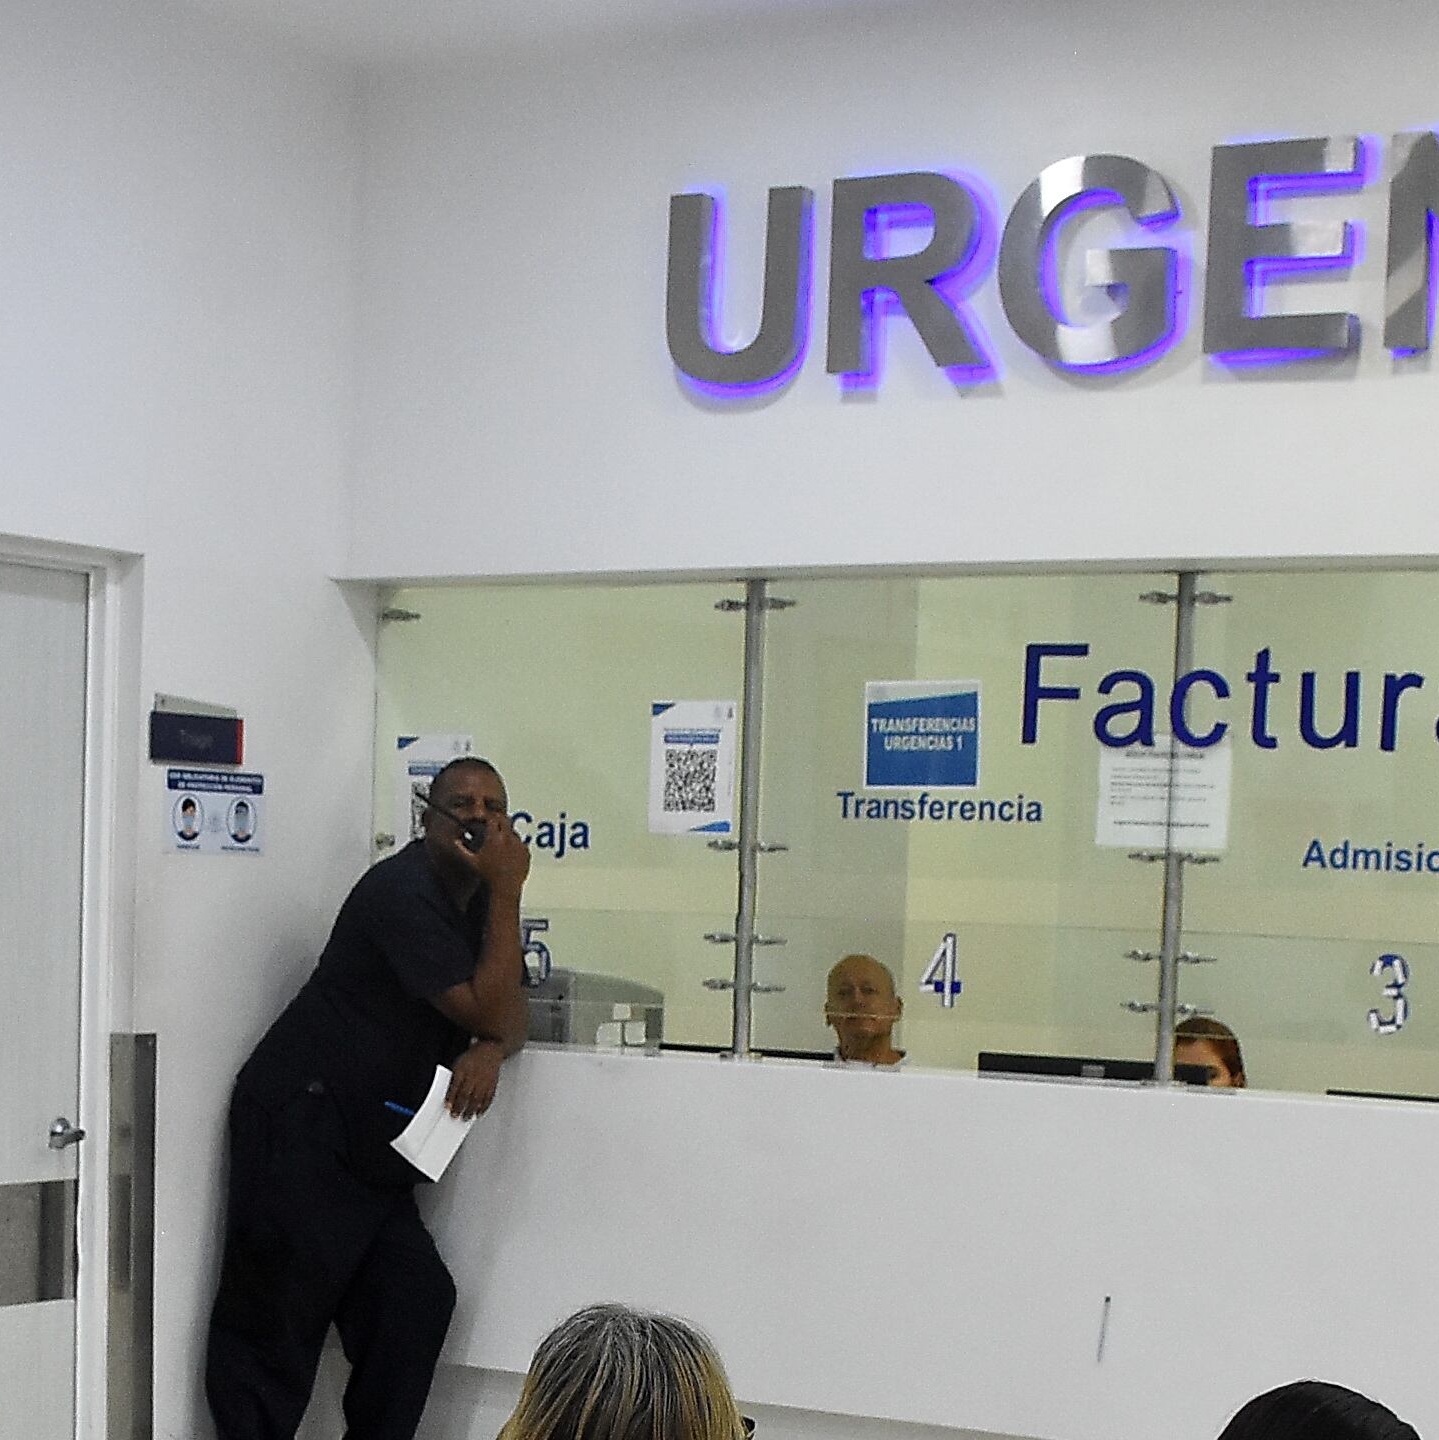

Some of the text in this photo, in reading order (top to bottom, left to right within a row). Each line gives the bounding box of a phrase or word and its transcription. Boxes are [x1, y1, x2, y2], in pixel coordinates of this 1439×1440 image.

[871, 717, 977, 734] TRANSFERENCIAS
[884, 735, 953, 751] URGENCIAS
[836, 790, 1043, 823] Transferencia
[511, 811, 591, 859] Caja
[521, 918, 551, 989] 5
[919, 932, 963, 1009] 4
[1366, 953, 1411, 1036] 3
